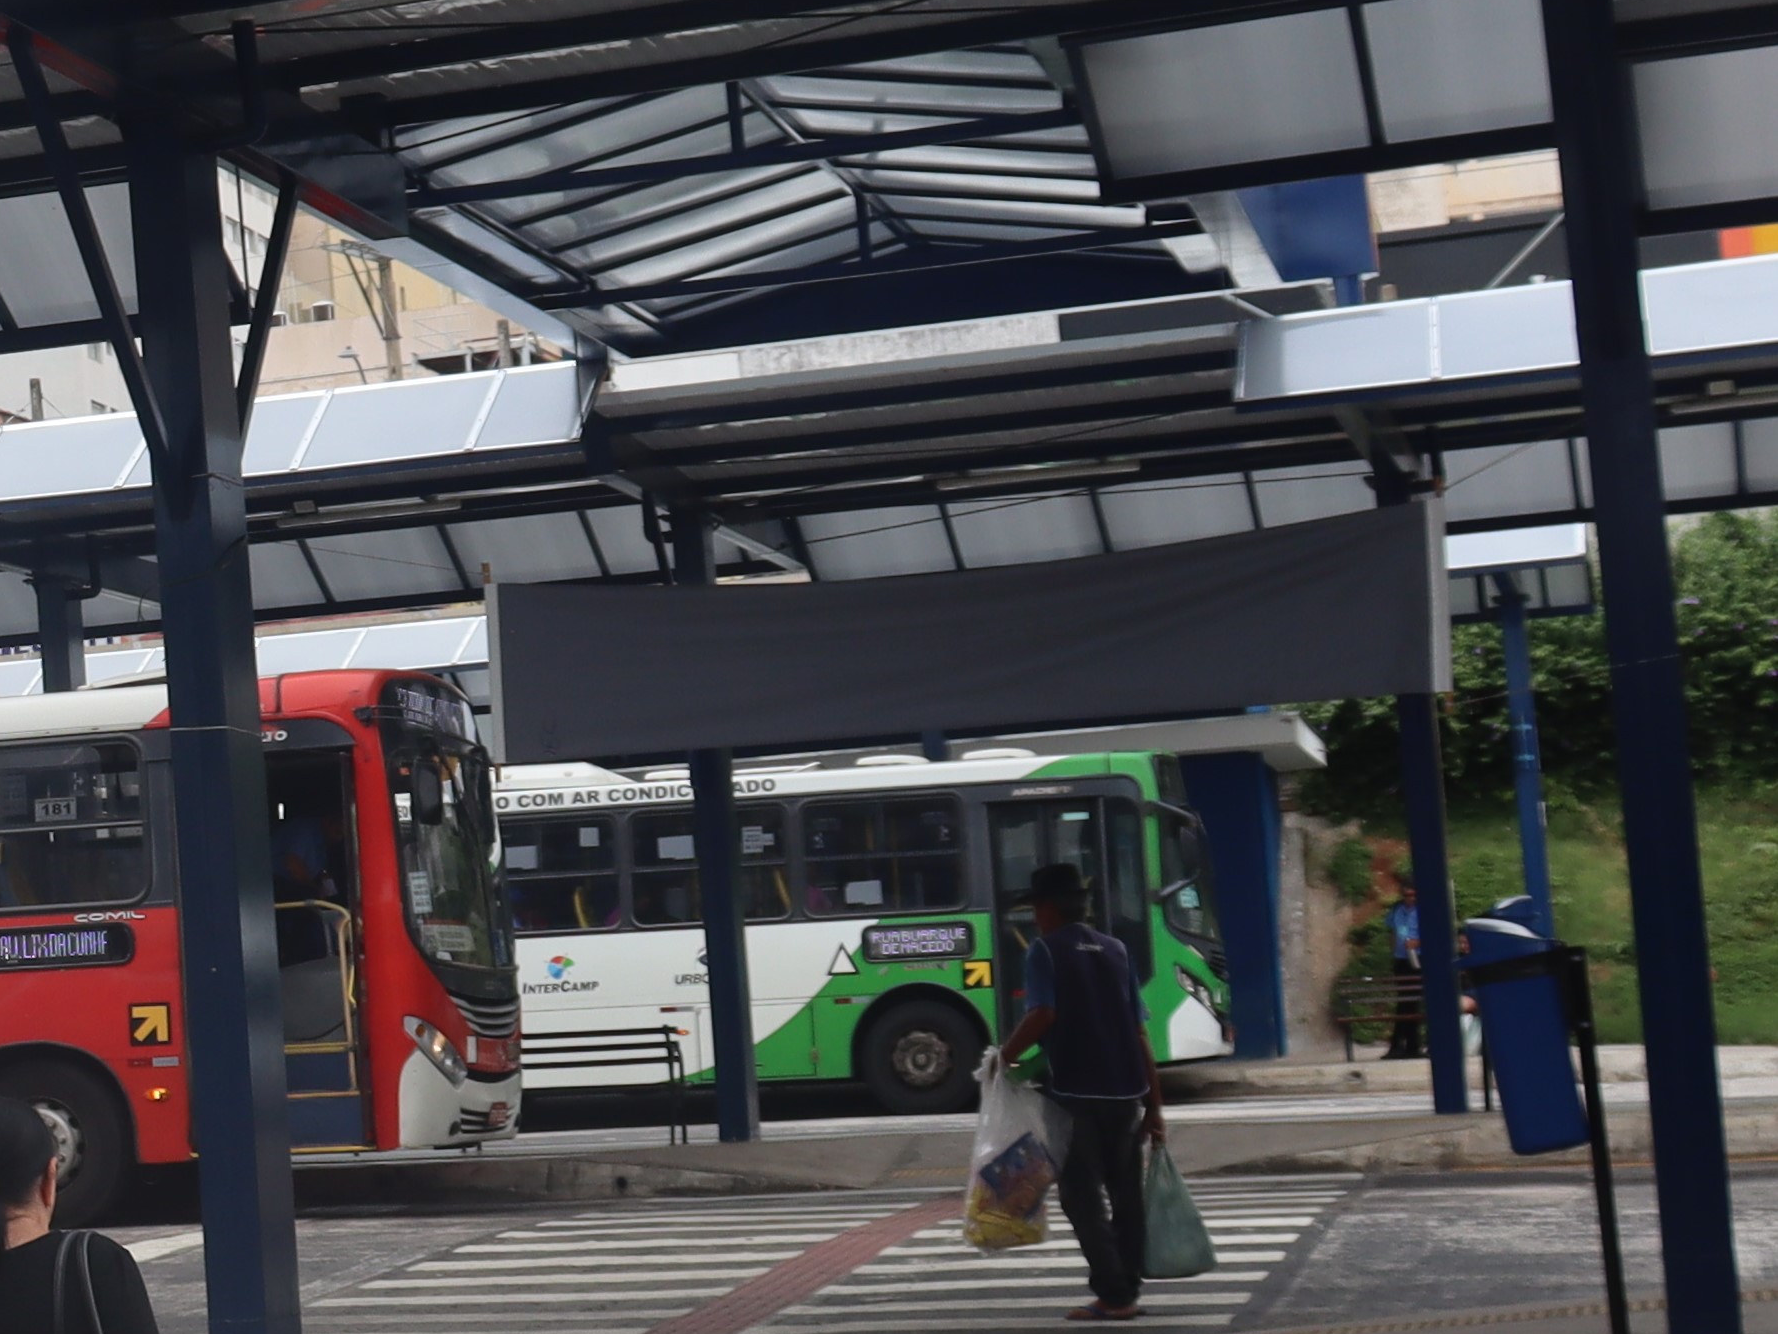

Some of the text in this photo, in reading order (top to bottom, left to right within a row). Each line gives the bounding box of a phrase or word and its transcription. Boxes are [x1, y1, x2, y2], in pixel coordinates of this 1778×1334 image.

[516, 793, 565, 809] COM
[571, 790, 601, 805] AR
[41, 802, 72, 816] 181
[73, 910, 146, 923] COMIL
